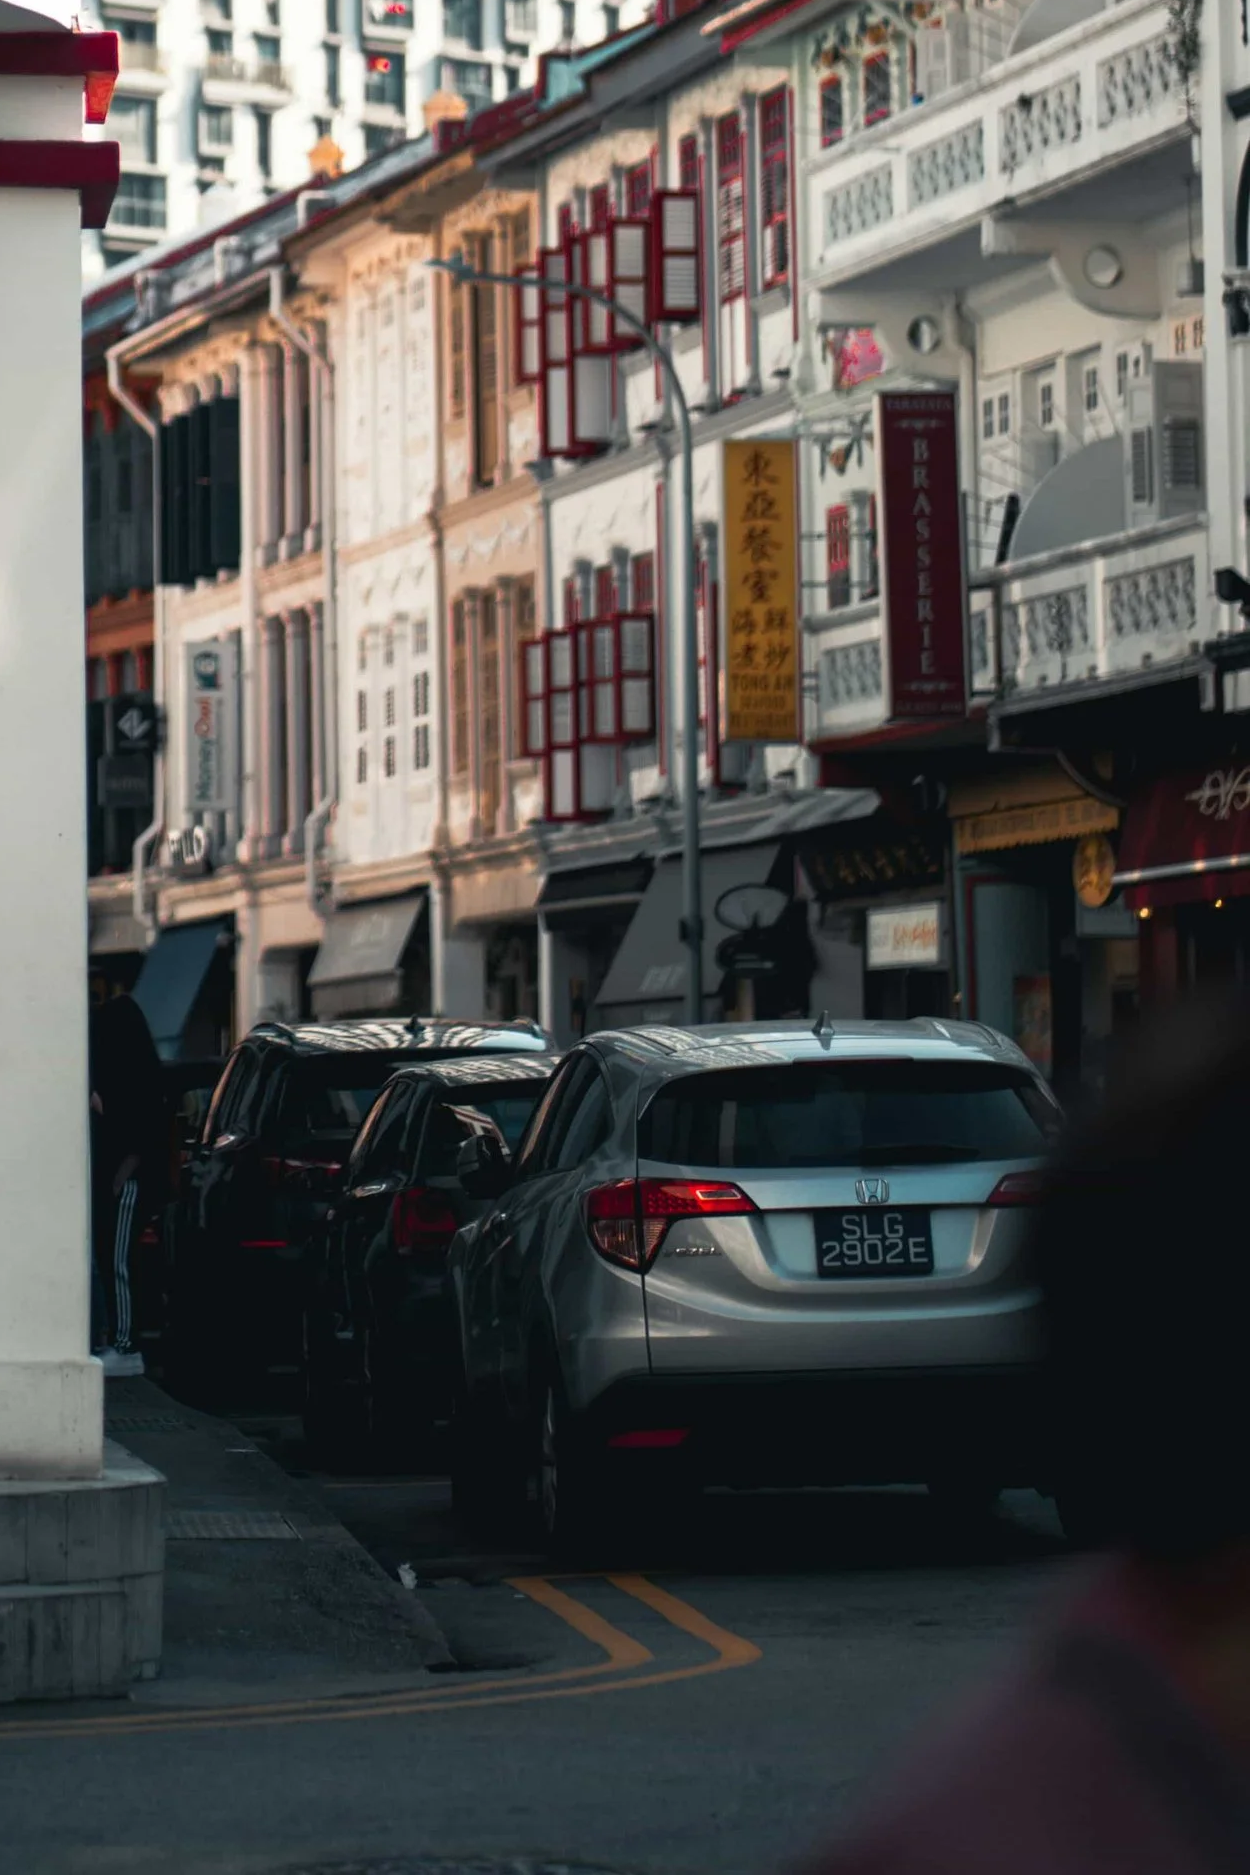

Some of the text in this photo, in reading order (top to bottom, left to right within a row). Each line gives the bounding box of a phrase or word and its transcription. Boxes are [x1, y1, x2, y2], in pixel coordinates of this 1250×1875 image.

[911, 435, 937, 675] BRASSERIE
[841, 1212, 904, 1240] SLG
[821, 1237, 929, 1267] 2902E
